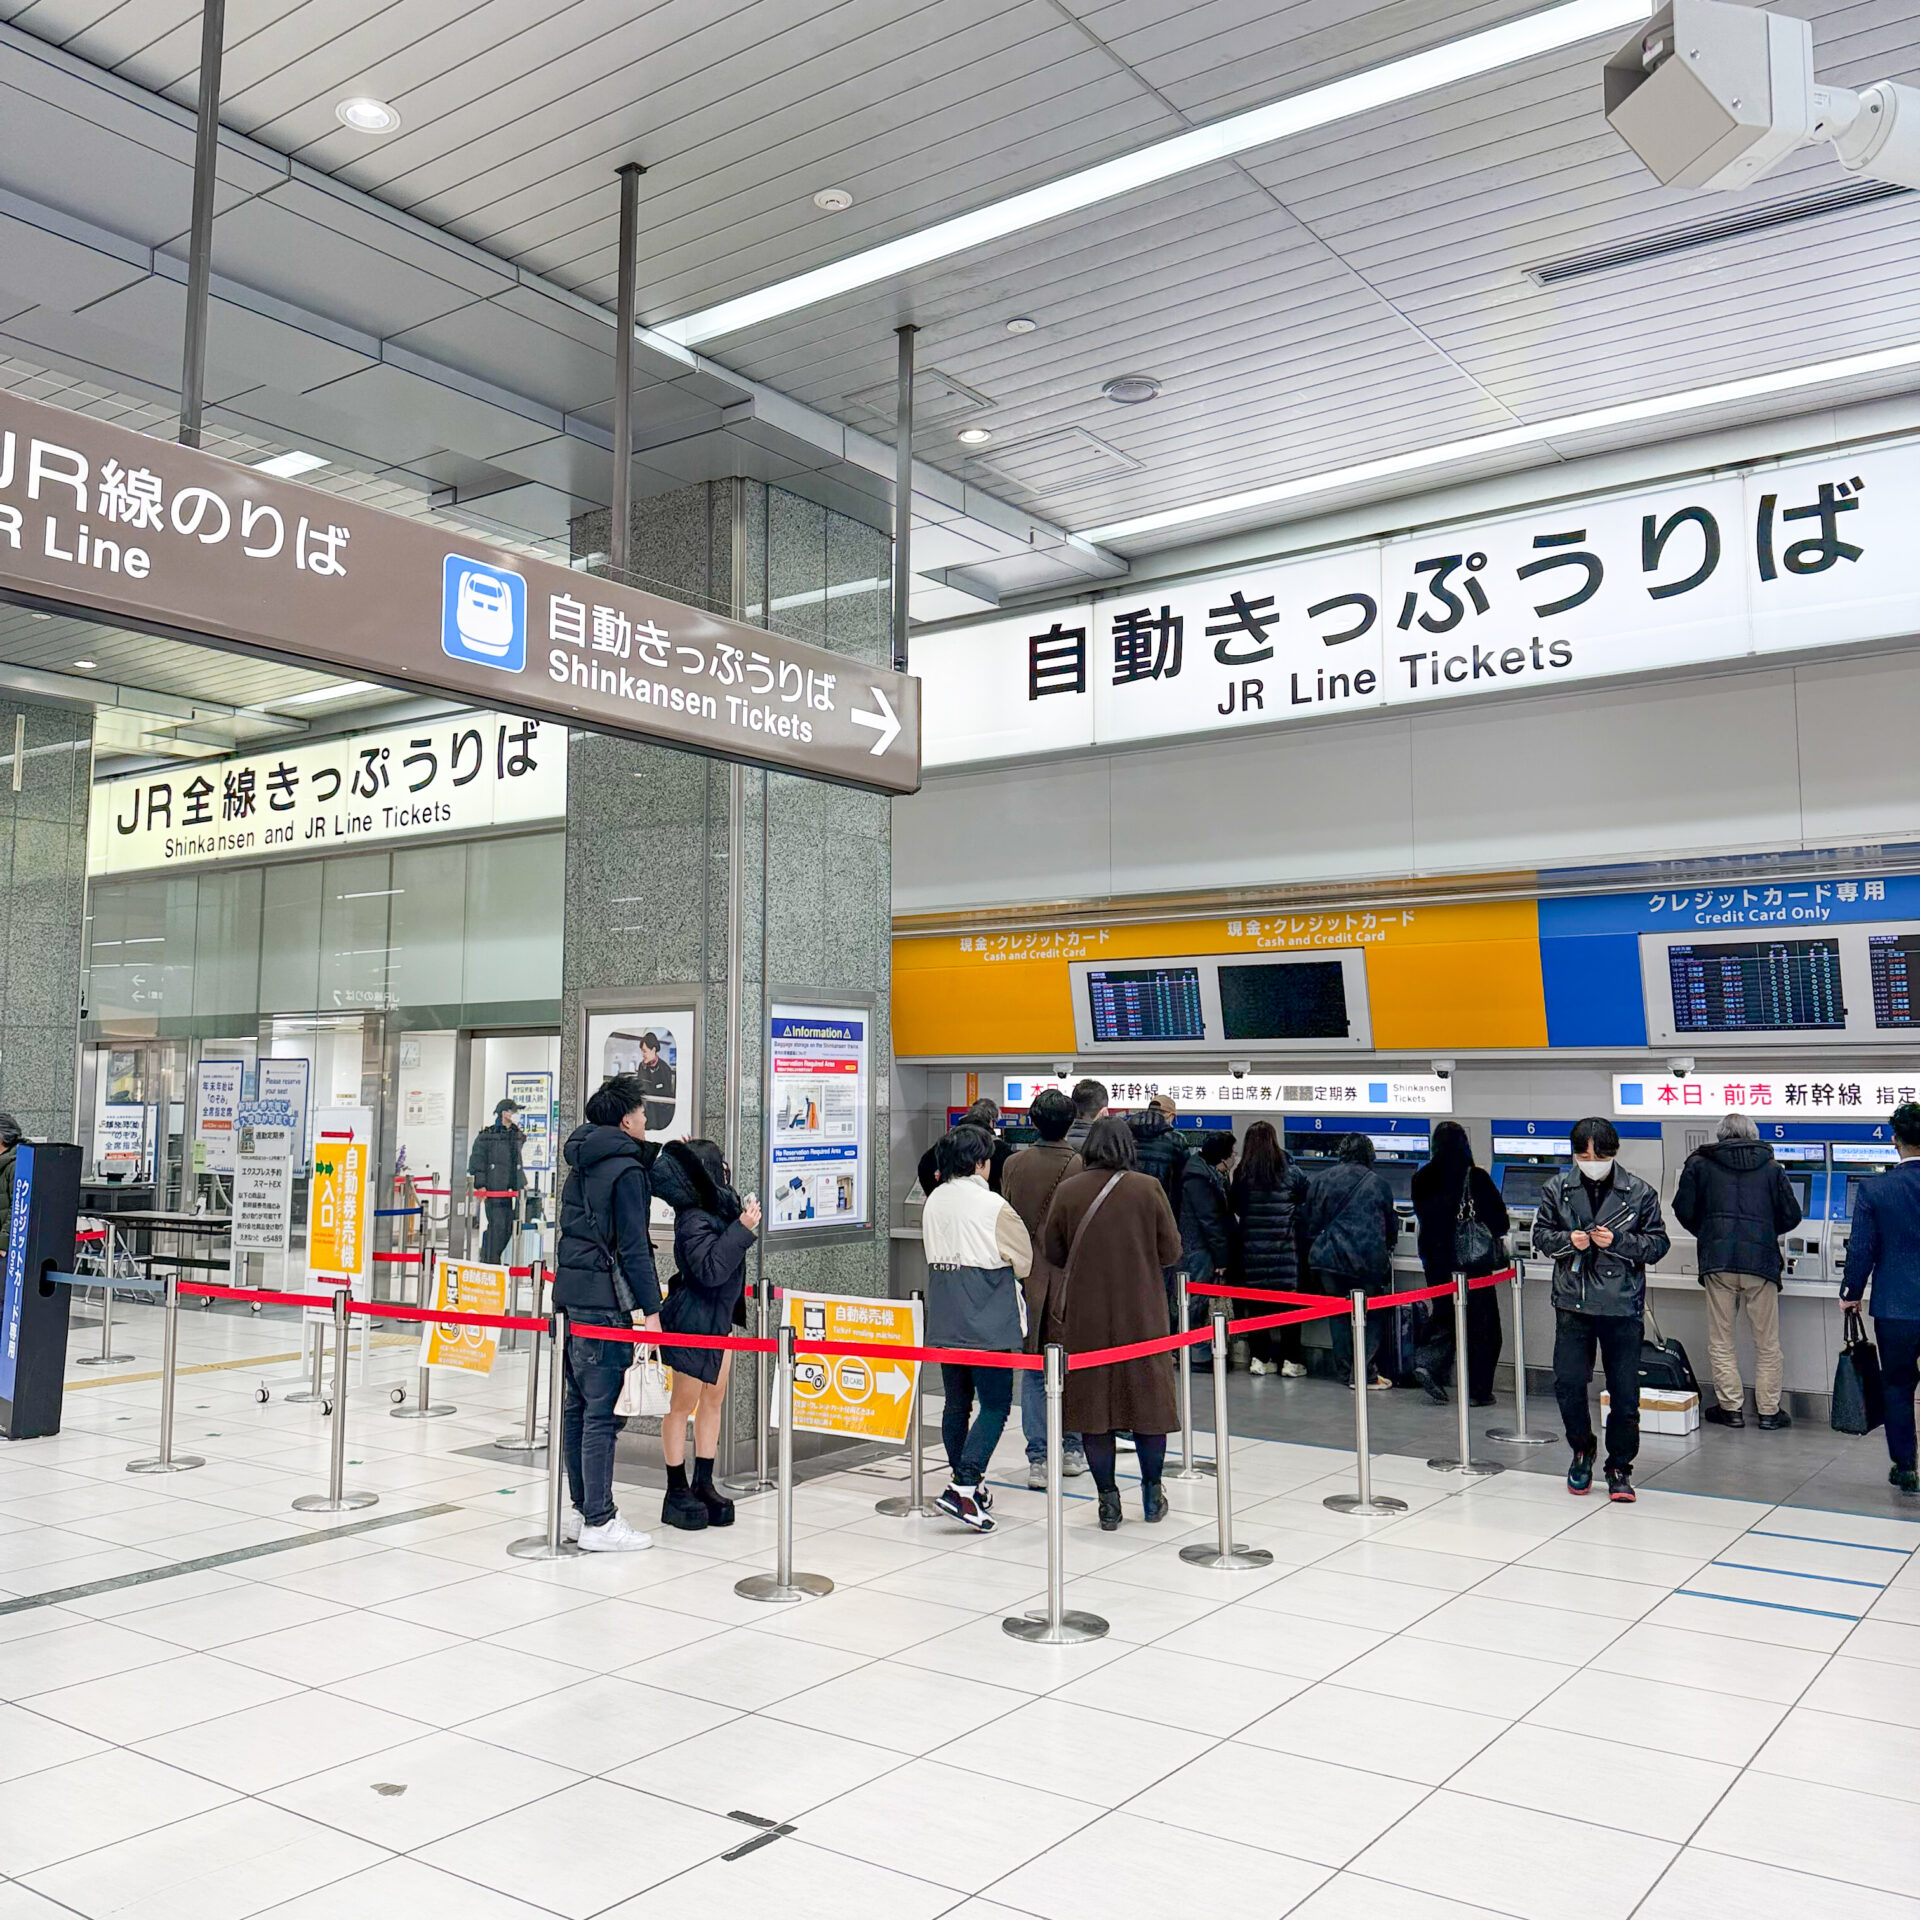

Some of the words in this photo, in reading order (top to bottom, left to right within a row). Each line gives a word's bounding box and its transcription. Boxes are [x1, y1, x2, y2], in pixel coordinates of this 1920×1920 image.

[0, 431, 351, 578] JR線のりば
[0, 504, 23, 549] R
[44, 516, 151, 579] Line
[1028, 475, 1865, 700] 自動きっぷうりば
[548, 592, 837, 712] 自動きっぷうりば
[1218, 678, 1264, 715] JR
[1291, 669, 1377, 705] Line
[1400, 636, 1573, 688] Tickets
[548, 648, 717, 719] Shinkansen
[725, 695, 813, 743] Tickets
[117, 719, 540, 835] JR全線きっぷうりば
[165, 828, 255, 858] Shinkansen
[265, 820, 294, 845] and
[305, 816, 326, 840] JR
[335, 811, 373, 837] Line
[382, 801, 451, 830] Tickets
[1648, 880, 1886, 913] クレジットカード専用
[1227, 910, 1415, 937] 現金・クレジットカード
[1695, 909, 1744, 925] Credit
[1749, 907, 1787, 922] Card
[1792, 905, 1831, 922] Only
[960, 929, 1110, 952] 現金・クレジットカード
[1257, 936, 1285, 948] Cash
[1288, 934, 1311, 946] and
[1314, 933, 1352, 945] Credit
[1356, 930, 1385, 942] Card
[983, 951, 1006, 961] Cash
[1008, 951, 1027, 960] and
[1030, 949, 1060, 959] Credit
[1063, 947, 1086, 957] Card
[792, 1025, 842, 1039] Information
[1111, 1083, 1159, 1101] 新幹線
[1393, 1084, 1446, 1093] Shinkansen
[1393, 1095, 1426, 1103] Tickets
[1657, 1084, 1772, 1105] 本日・前売
[1785, 1083, 1862, 1106] 新幹線
[1876, 1086, 1920, 1105] 指定
[203, 1107, 232, 1117] 全席指定席
[1195, 1117, 1202, 1128] 9
[1314, 1119, 1322, 1130] 8
[1390, 1120, 1398, 1131] 7
[1527, 1122, 1536, 1134] 6
[1775, 1125, 1785, 1138] 5
[1872, 1126, 1884, 1139] 4
[241, 1167, 282, 1177] エクスプレス予約
[254, 1180, 281, 1188] スマートEX
[13, 1179, 22, 1215] Credit
[321, 1180, 335, 1227] 入口
[341, 1146, 358, 1269] 自動券売機
[11, 1217, 19, 1247] Card
[262, 1234, 282, 1243] e5489
[8, 1250, 17, 1278] Only
[8, 1179, 30, 1360] クレジットカード専用
[835, 1304, 895, 1327] 自動券売機
[833, 1325, 851, 1335] Ticket
[876, 1331, 901, 1340] machine
